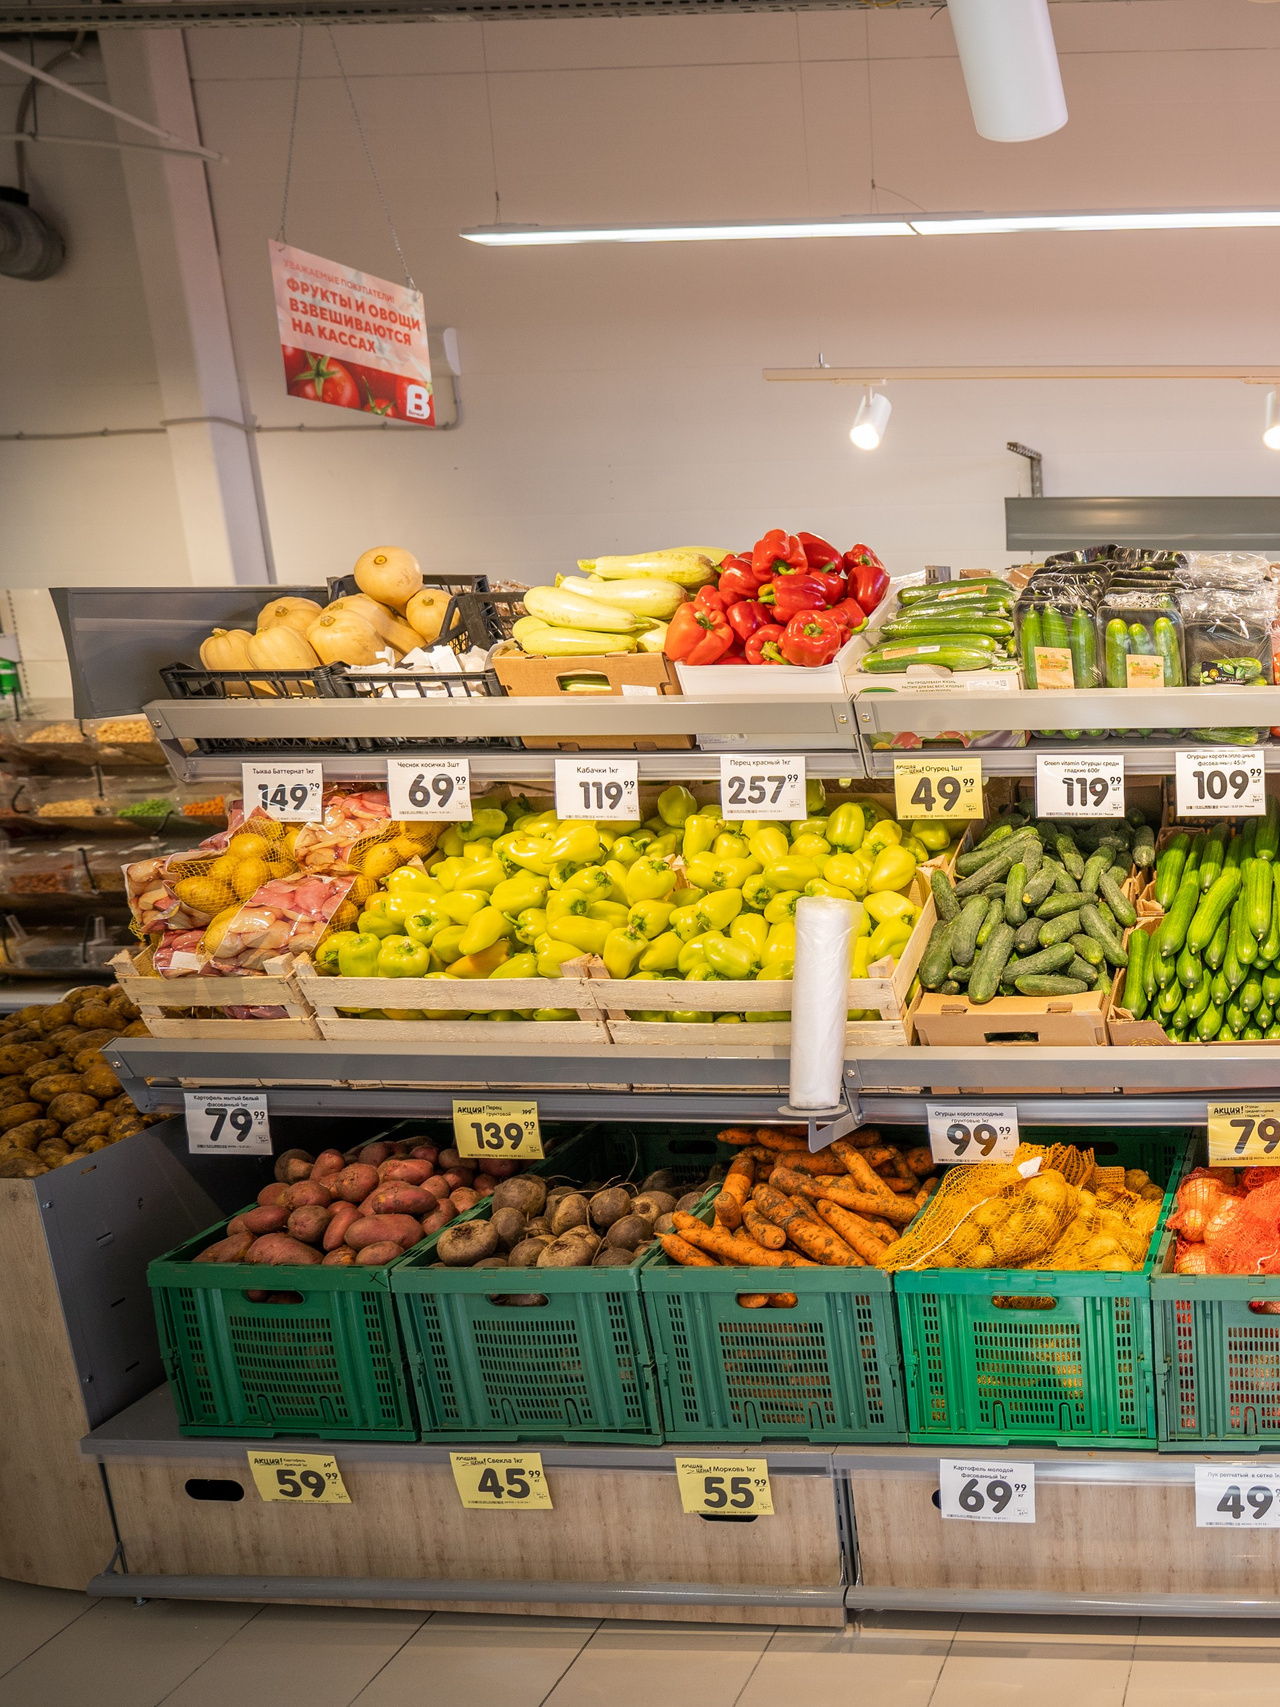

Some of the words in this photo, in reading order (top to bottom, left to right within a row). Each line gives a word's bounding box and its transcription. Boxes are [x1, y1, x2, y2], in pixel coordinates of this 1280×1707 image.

[283, 259, 340, 285] УВАЖАЕМЫЕ
[340, 278, 395, 303] ПОКУПАТЕЛИ!
[286, 277, 352, 310] ФРУКТЫ
[355, 299, 365, 314] И
[368, 304, 421, 332] ОВОЩИ
[289, 297, 412, 346] ВЗВЕШИВАЮТСЯ
[291, 318, 315, 337] НА
[317, 325, 377, 354] КАССАХ
[258, 784, 308, 812] 149
[408, 773, 454, 808] 69
[455, 776, 466, 784] 99
[579, 781, 623, 810] 119
[624, 781, 635, 789] 99
[728, 775, 786, 804] 257
[787, 774, 799, 782] 99
[911, 777, 961, 812] 49
[963, 778, 975, 786] 99
[1062, 777, 1109, 807] 119
[1193, 770, 1249, 799] 109
[1250, 768, 1262, 776] 99
[205, 1108, 253, 1142] 79
[253, 1111, 265, 1119] 99
[457, 1106, 485, 1114] АКЦИЯ!
[1213, 1106, 1244, 1115] АКЦИЯ!
[471, 1122, 524, 1150] 139
[524, 1121, 535, 1129] 99
[947, 1123, 998, 1157] 99
[999, 1126, 1011, 1134] 99
[254, 1457, 283, 1467] АКЦИЯ!
[470, 1458, 486, 1466] ЦЕНА!
[696, 1466, 712, 1474] ЦЕНА!
[953, 1465, 986, 1473] Картофель
[276, 1469, 326, 1498] 59
[478, 1468, 531, 1499] 45
[528, 1470, 541, 1478] 99
[704, 1477, 754, 1509] 55
[958, 1478, 1013, 1514] 69
[1014, 1484, 1027, 1492] 99
[1216, 1485, 1273, 1520] 49
